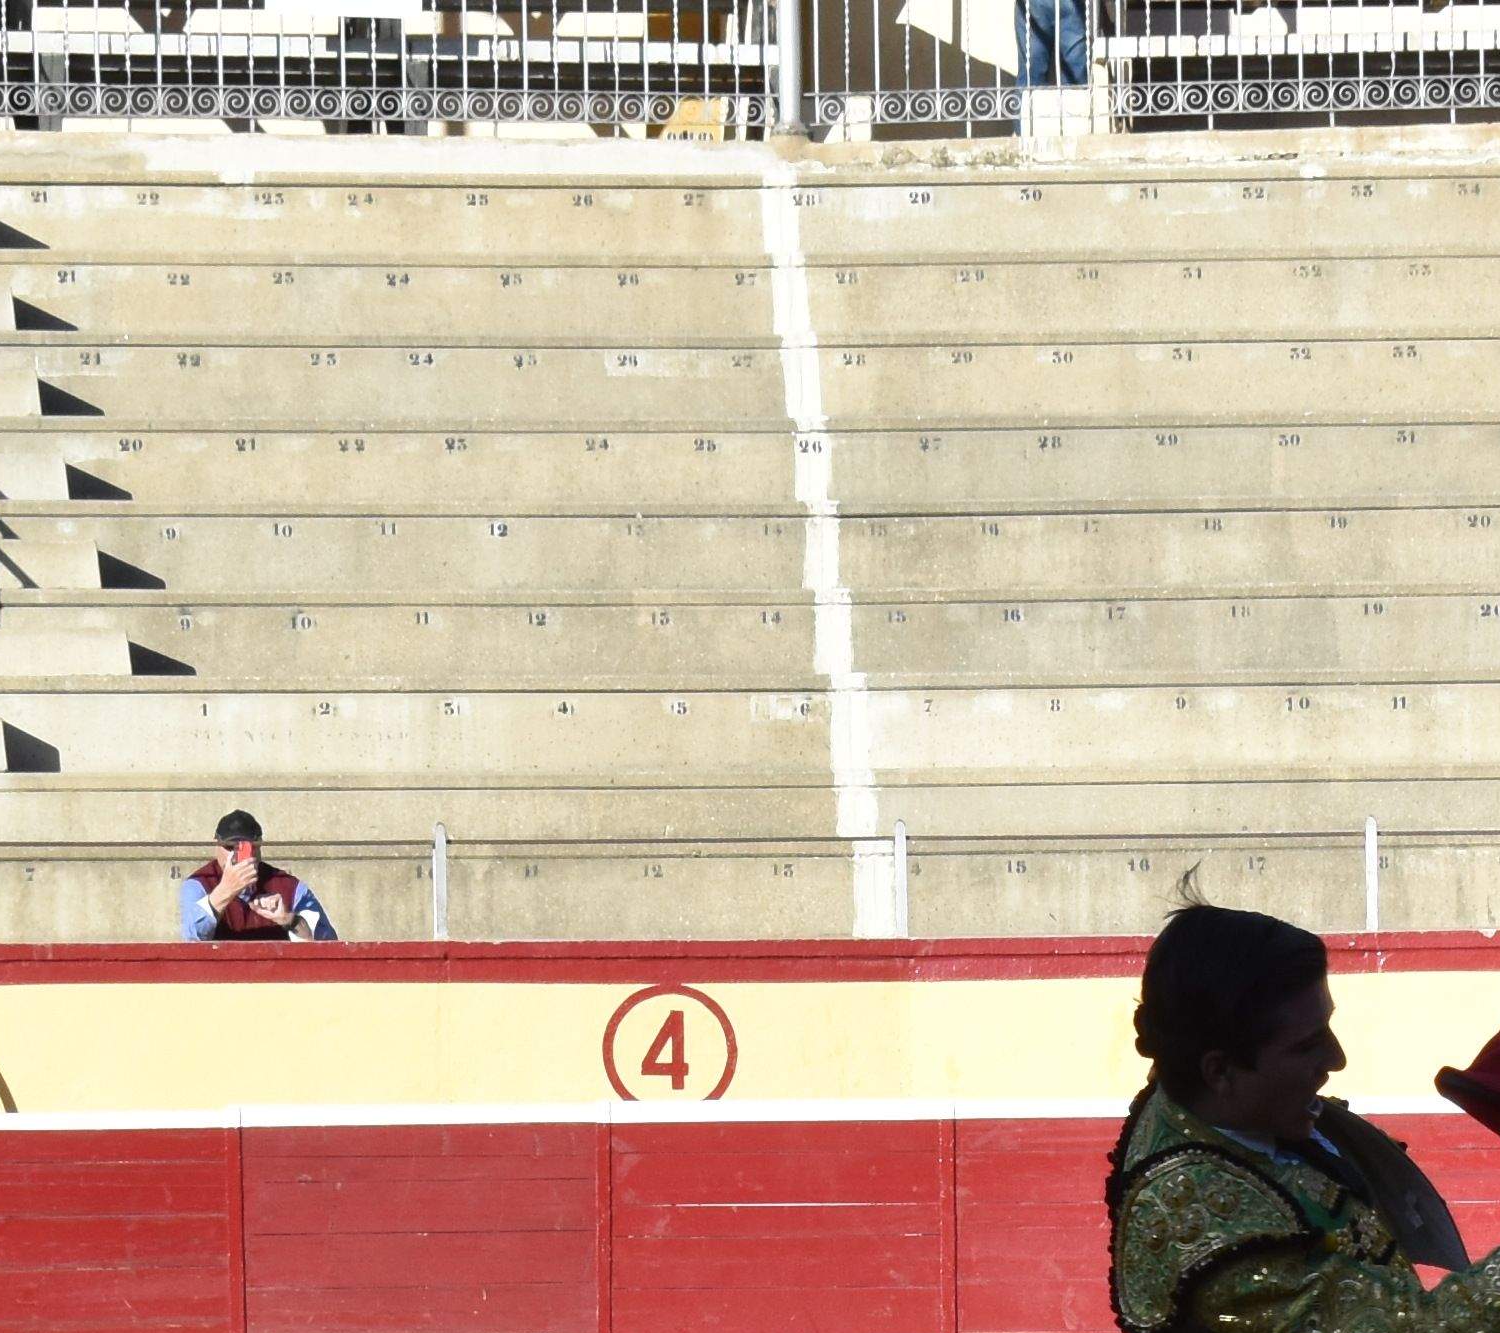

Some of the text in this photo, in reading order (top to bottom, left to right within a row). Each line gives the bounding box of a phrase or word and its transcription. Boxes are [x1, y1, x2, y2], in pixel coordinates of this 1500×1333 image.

[31, 191, 47, 203] 21
[348, 193, 373, 206] 24
[573, 195, 593, 206] 26
[793, 194, 815, 206] 28
[910, 193, 930, 204] 29
[58, 271, 75, 283] 21
[386, 273, 409, 286] 24
[618, 273, 639, 287] 26
[80, 352, 100, 365] 21
[177, 353, 200, 367] 22
[409, 353, 433, 365] 24
[119, 439, 142, 451] 20
[236, 438, 255, 452] 21
[339, 439, 364, 452] 22
[586, 439, 608, 451] 24
[1038, 436, 1061, 450] 28
[1331, 516, 1347, 528] 19
[1468, 515, 1490, 527] 20
[166, 529, 176, 539] 9
[274, 523, 292, 537] 10
[491, 524, 508, 537] 12
[1364, 603, 1383, 615] 19
[416, 612, 428, 624] 11
[529, 612, 546, 626] 12
[762, 612, 781, 624] 14
[1003, 609, 1020, 622] 16
[291, 617, 311, 629] 10
[320, 703, 330, 715] 2
[1051, 699, 1060, 711] 8
[1176, 697, 1186, 709] 9
[1286, 697, 1310, 711] 10
[1393, 697, 1405, 709] 11
[171, 866, 181, 879] 8
[641, 1010, 689, 1090] 4
